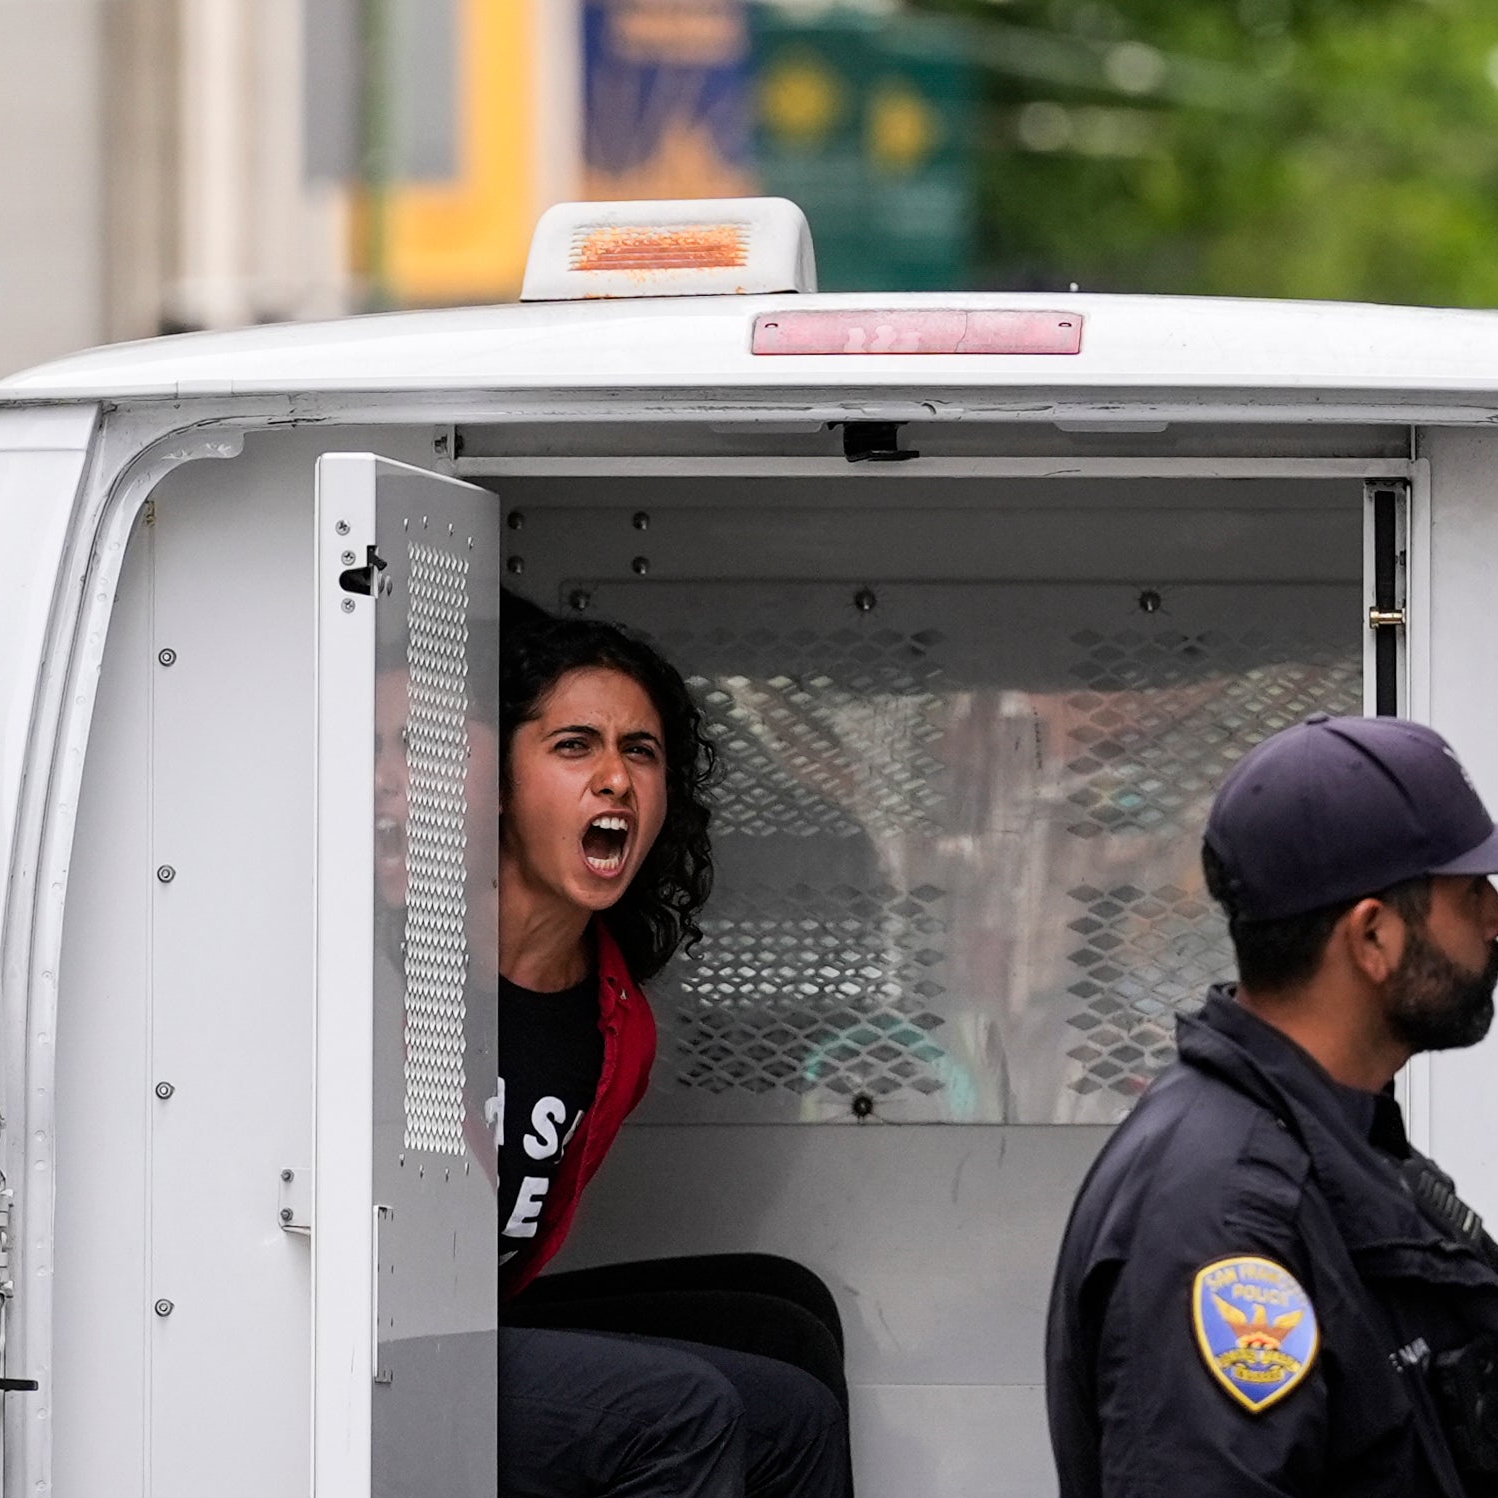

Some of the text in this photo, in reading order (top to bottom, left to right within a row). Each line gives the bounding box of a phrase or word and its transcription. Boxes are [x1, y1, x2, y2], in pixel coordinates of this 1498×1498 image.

[498, 1176, 549, 1238] E
[1204, 1267, 1237, 1293] SAN
[1232, 1283, 1289, 1306] POLICE
